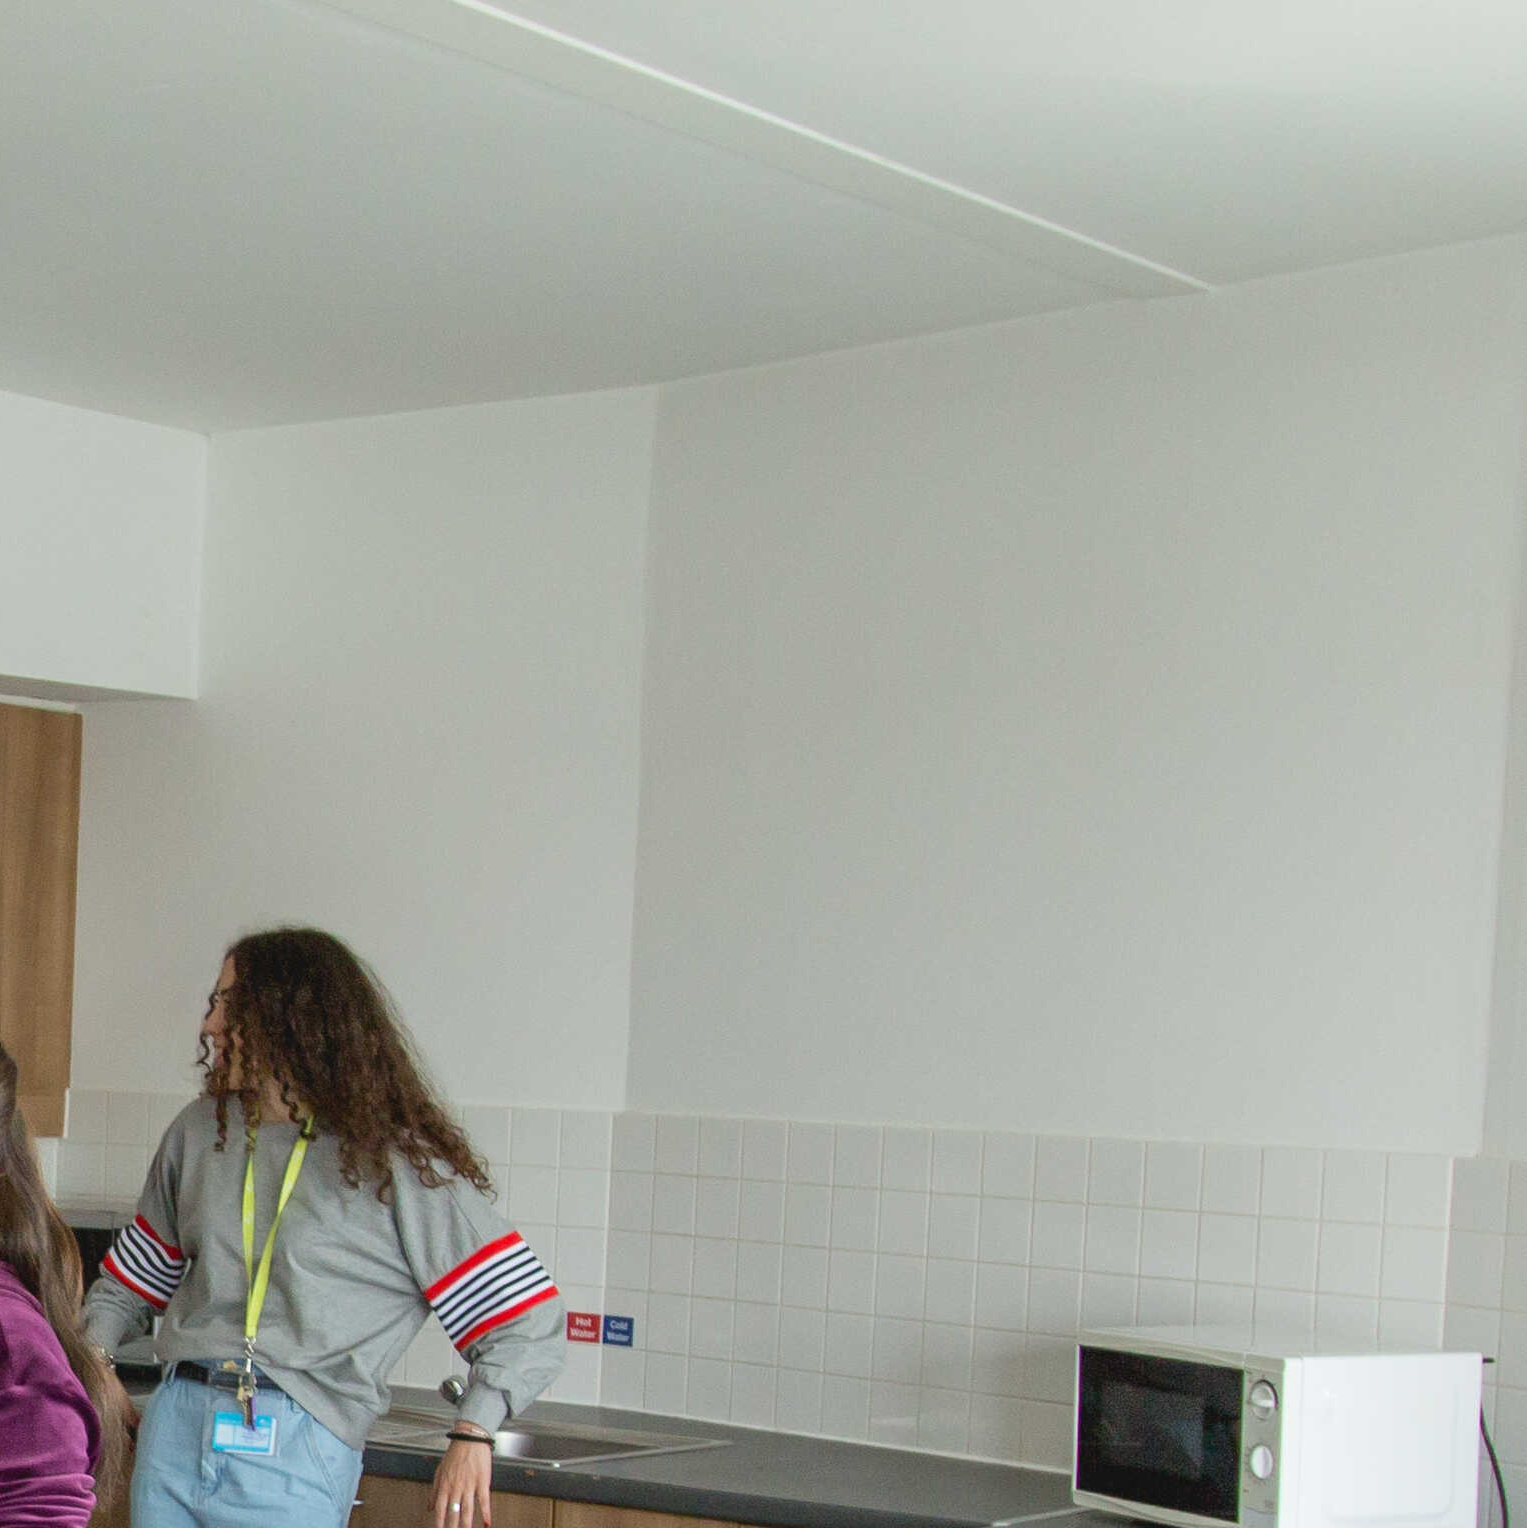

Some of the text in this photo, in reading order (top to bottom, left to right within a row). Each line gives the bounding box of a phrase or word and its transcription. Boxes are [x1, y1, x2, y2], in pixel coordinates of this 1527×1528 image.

[575, 1316, 592, 1327] Hot
[609, 1319, 629, 1331] Cold
[569, 1327, 597, 1339] Water
